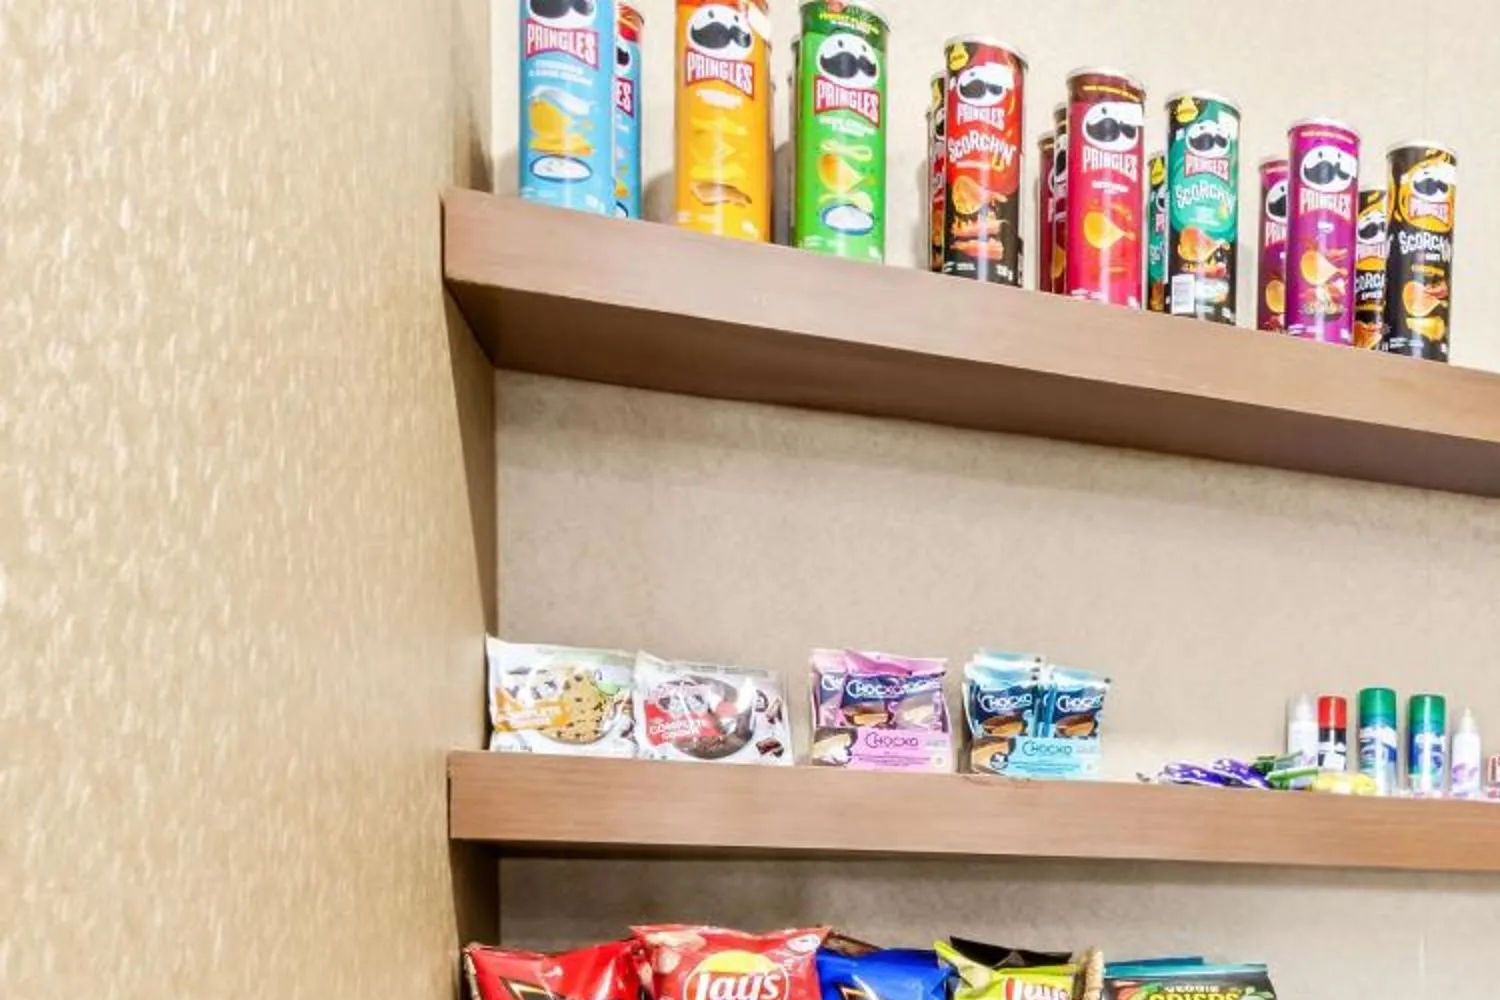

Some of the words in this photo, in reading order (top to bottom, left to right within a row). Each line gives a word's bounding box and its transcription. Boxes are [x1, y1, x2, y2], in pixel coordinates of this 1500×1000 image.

[526, 27, 598, 66] PRINGLES
[686, 52, 754, 94] PRINGLES
[816, 79, 880, 124] PRINGLES
[1083, 146, 1138, 182] PRINGLES
[1301, 187, 1351, 219] PRINGLES
